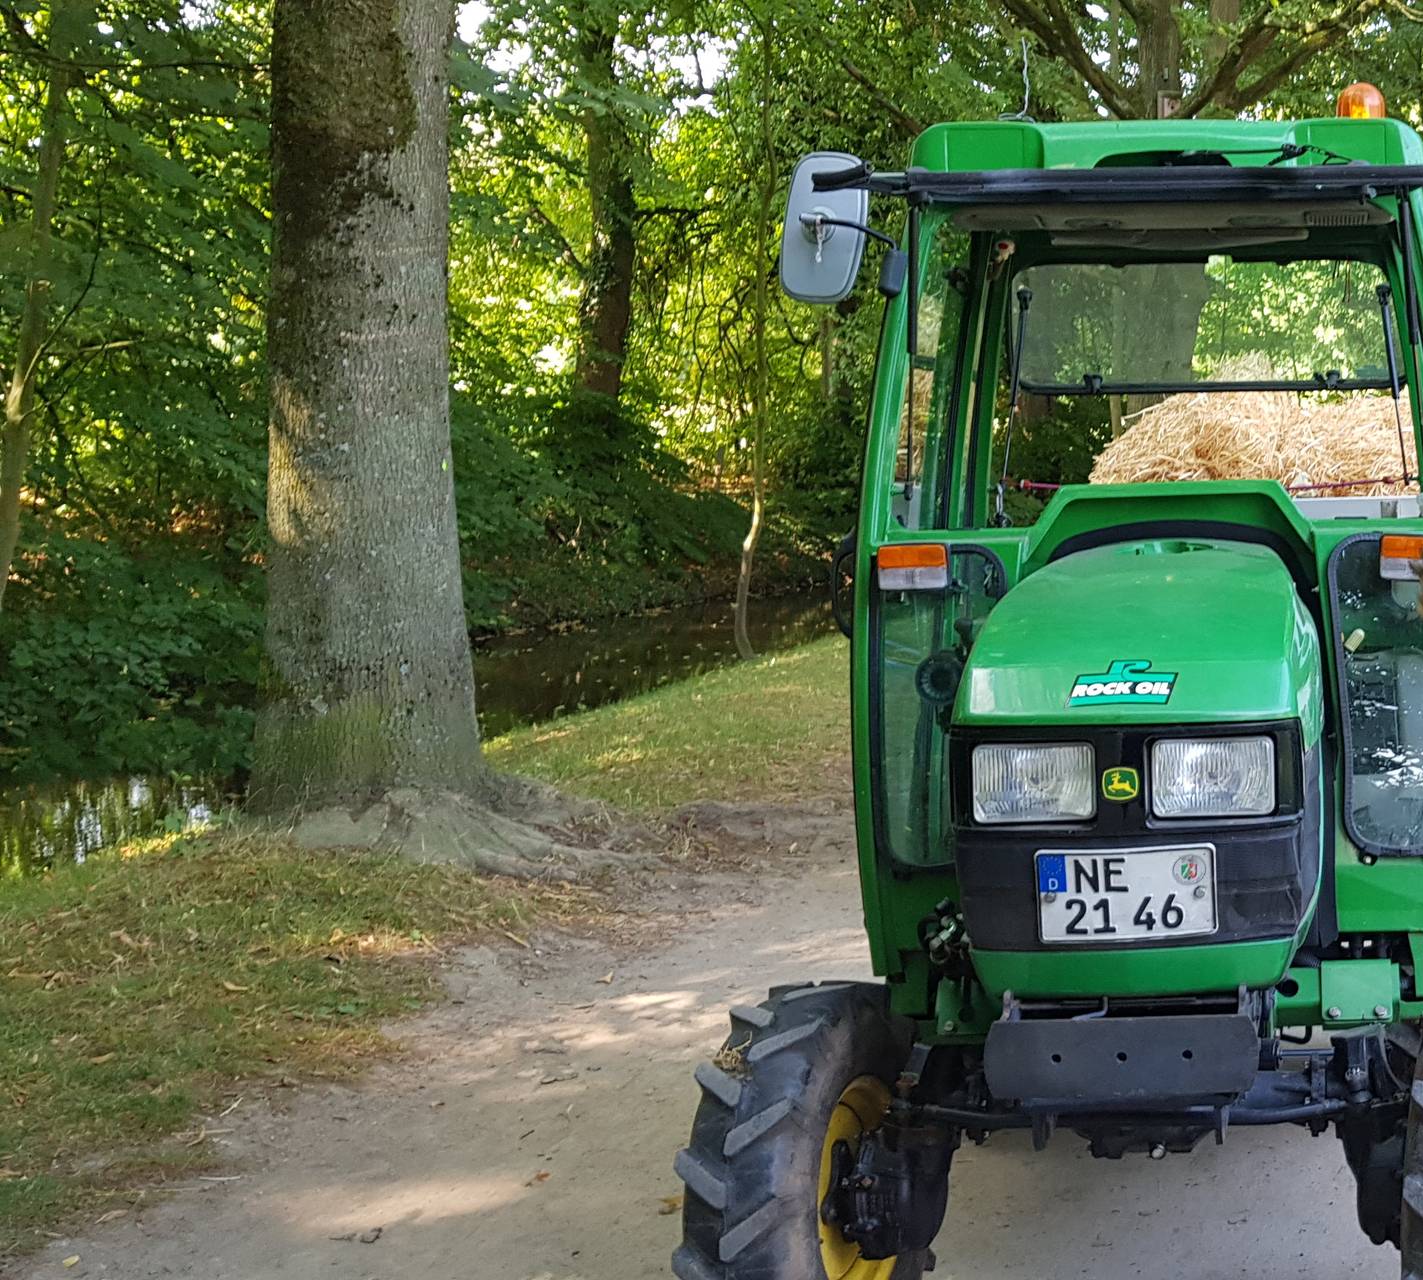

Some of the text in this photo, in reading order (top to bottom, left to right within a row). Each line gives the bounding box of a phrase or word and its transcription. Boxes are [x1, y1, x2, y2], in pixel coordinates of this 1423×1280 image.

[1071, 681, 1171, 698] ROCK OIL
[1073, 858, 1129, 893] NE
[1048, 878, 1059, 891] D
